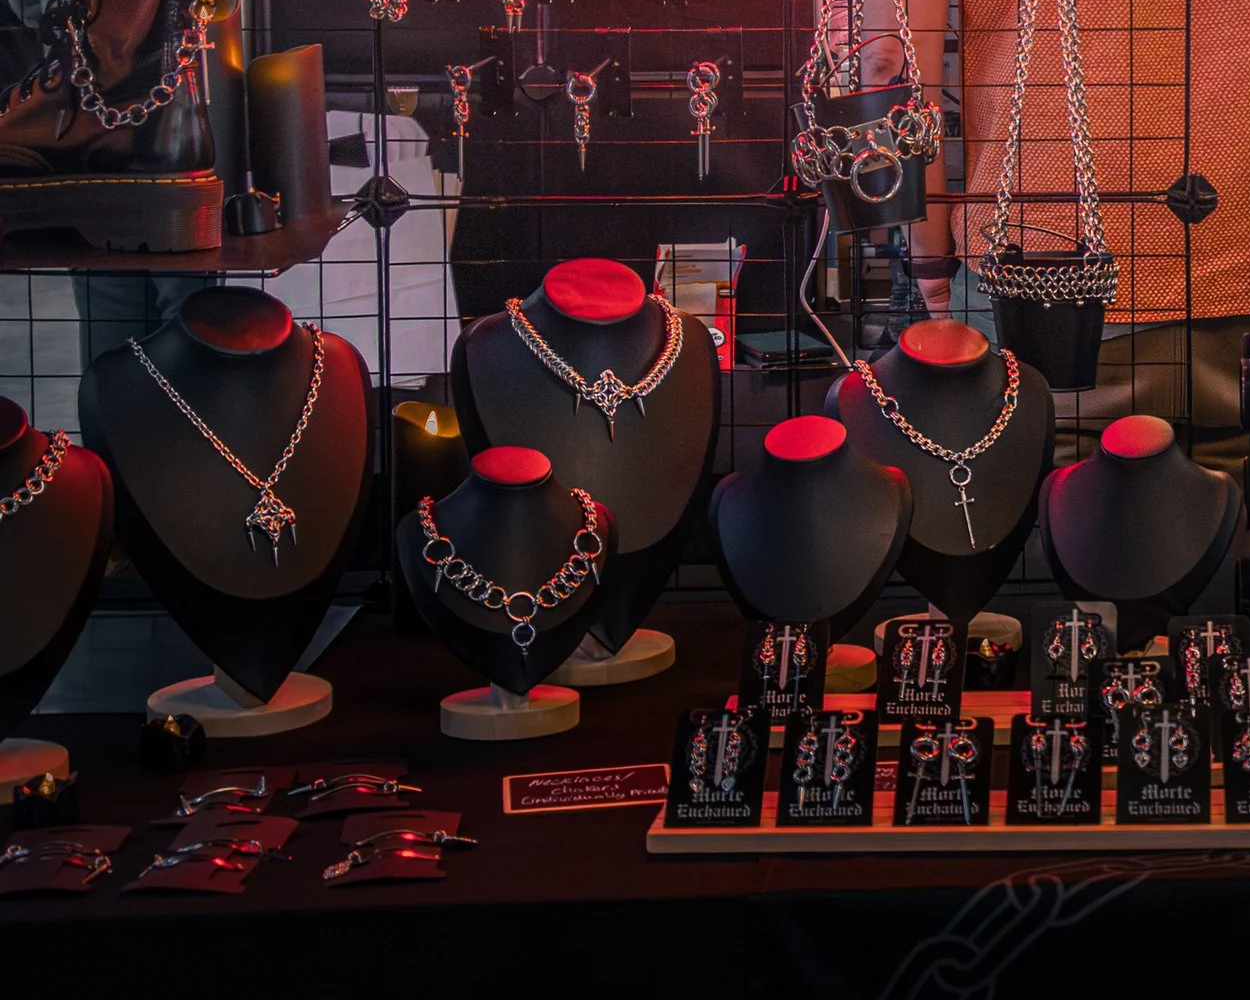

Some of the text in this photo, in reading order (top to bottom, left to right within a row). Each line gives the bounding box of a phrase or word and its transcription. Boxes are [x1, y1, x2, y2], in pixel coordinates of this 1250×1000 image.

[886, 702, 952, 716] Enchained
[1141, 784, 1193, 800] Morte
[677, 804, 751, 820] Enchained
[1128, 800, 1201, 816] Enchained
